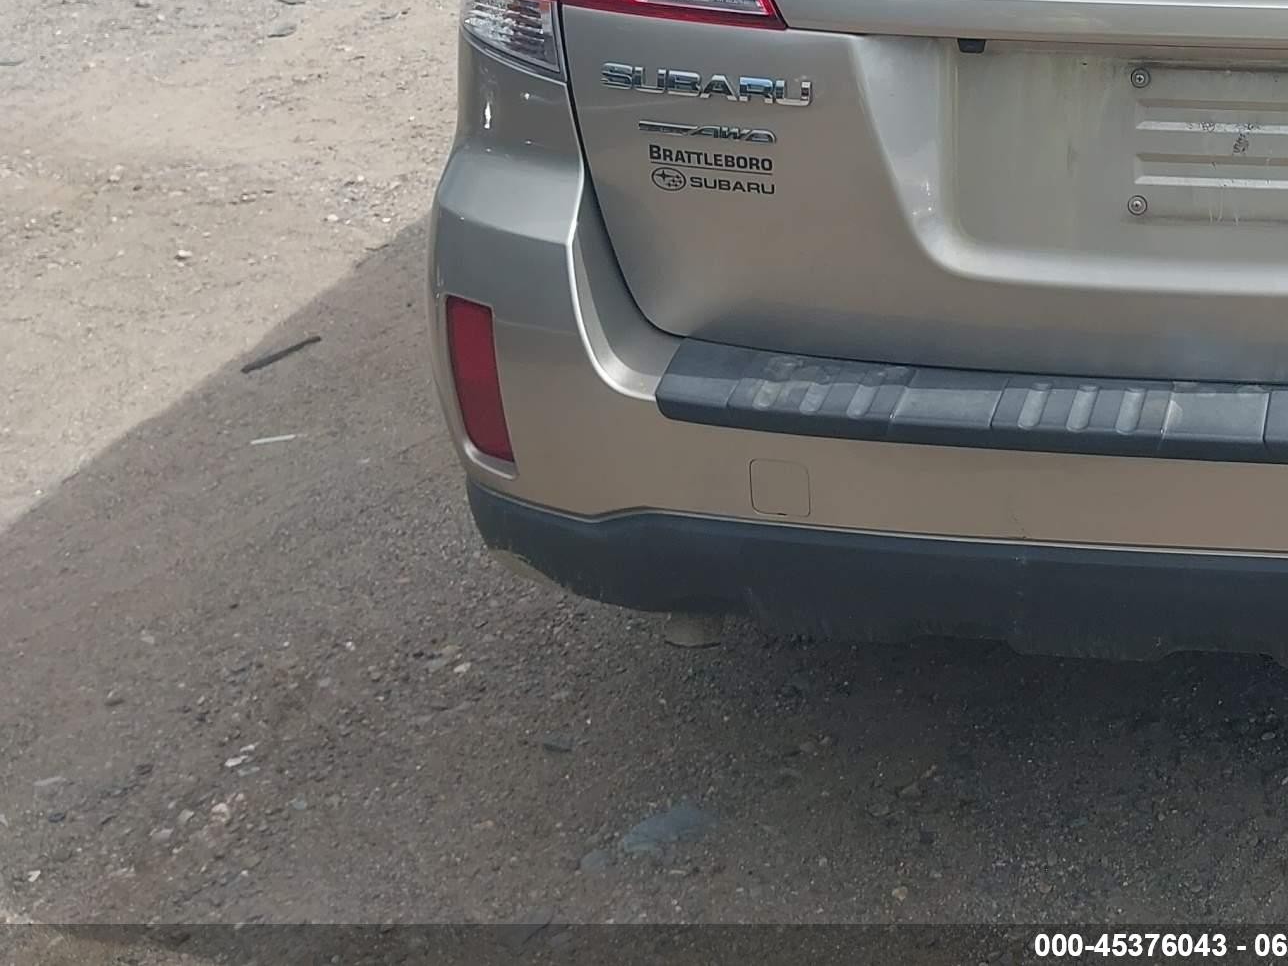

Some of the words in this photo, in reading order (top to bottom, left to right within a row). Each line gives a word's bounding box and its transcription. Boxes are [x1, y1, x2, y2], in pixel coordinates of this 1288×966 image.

[600, 62, 813, 107] SUBARU
[648, 143, 774, 172] BRATTLEBORO
[689, 175, 776, 195] SUBARU
